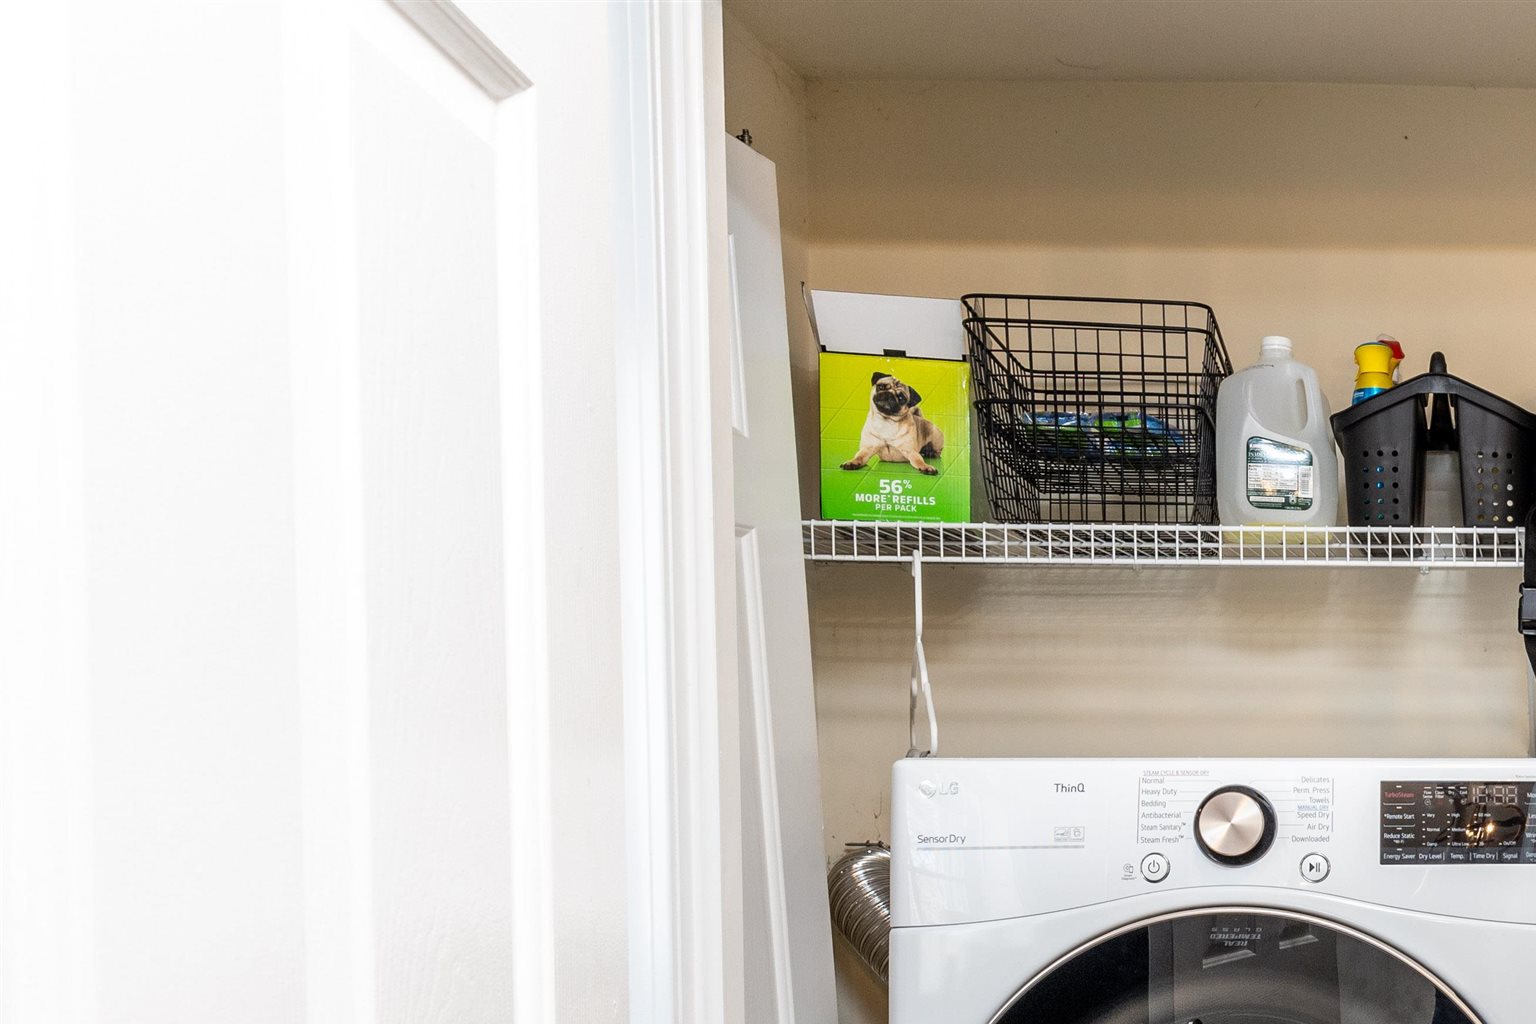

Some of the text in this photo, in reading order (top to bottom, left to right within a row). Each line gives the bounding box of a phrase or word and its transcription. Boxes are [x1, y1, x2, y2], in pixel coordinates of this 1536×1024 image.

[879, 479, 912, 494] 56%
[893, 496, 936, 505] REFILLS
[875, 503, 917, 512] PER PACK
[938, 782, 959, 796] LG
[1054, 783, 1086, 793] ThinQ
[1141, 788, 1177, 796] Heavy Duty
[1141, 800, 1166, 808] Bedding
[1309, 796, 1330, 804] Towels
[1318, 812, 1330, 820] Dry
[1318, 823, 1330, 831] Dry
[1486, 852, 1495, 860] Dry
